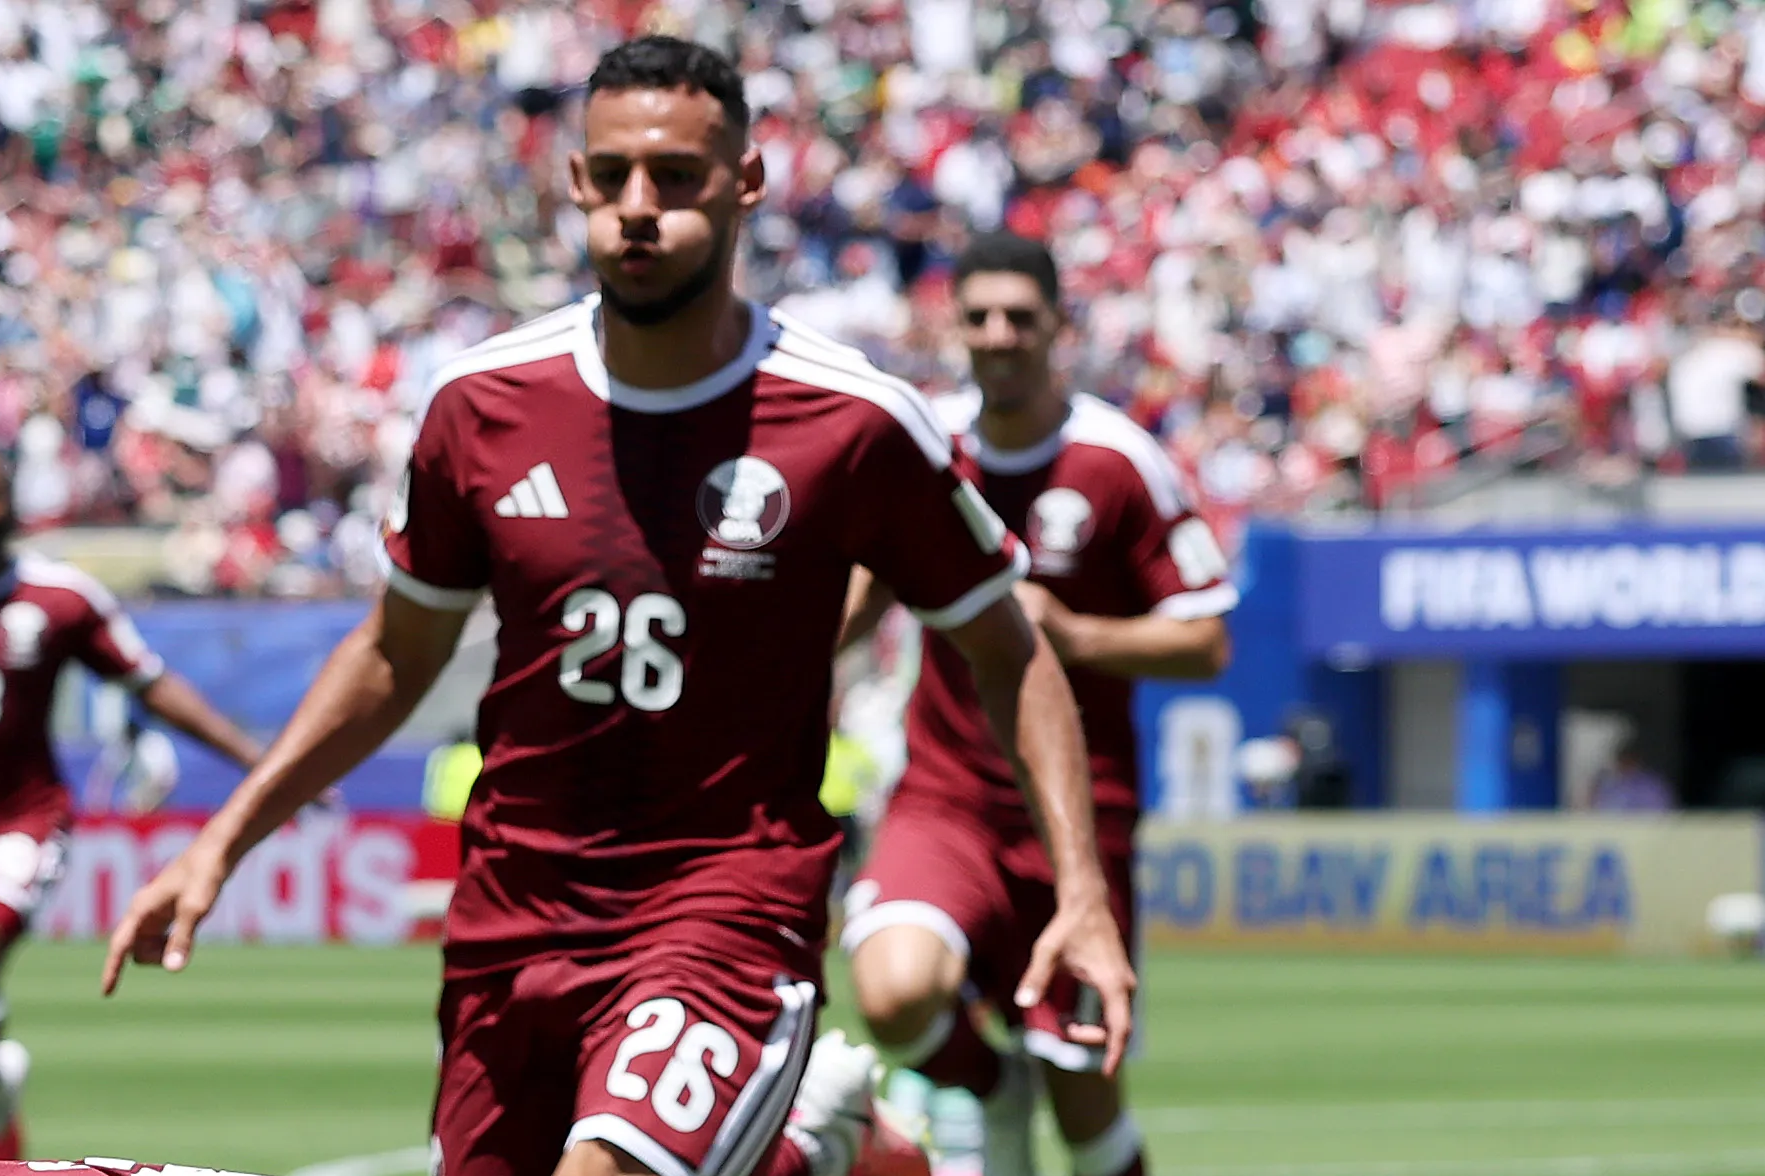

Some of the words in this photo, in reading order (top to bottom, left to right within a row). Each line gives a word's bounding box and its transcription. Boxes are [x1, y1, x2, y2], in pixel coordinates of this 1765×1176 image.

[1379, 547, 1534, 631] FIFA
[558, 587, 686, 711] 26
[1235, 838, 1389, 929] BAY
[1404, 838, 1633, 932] AREA
[606, 997, 739, 1133] 26
